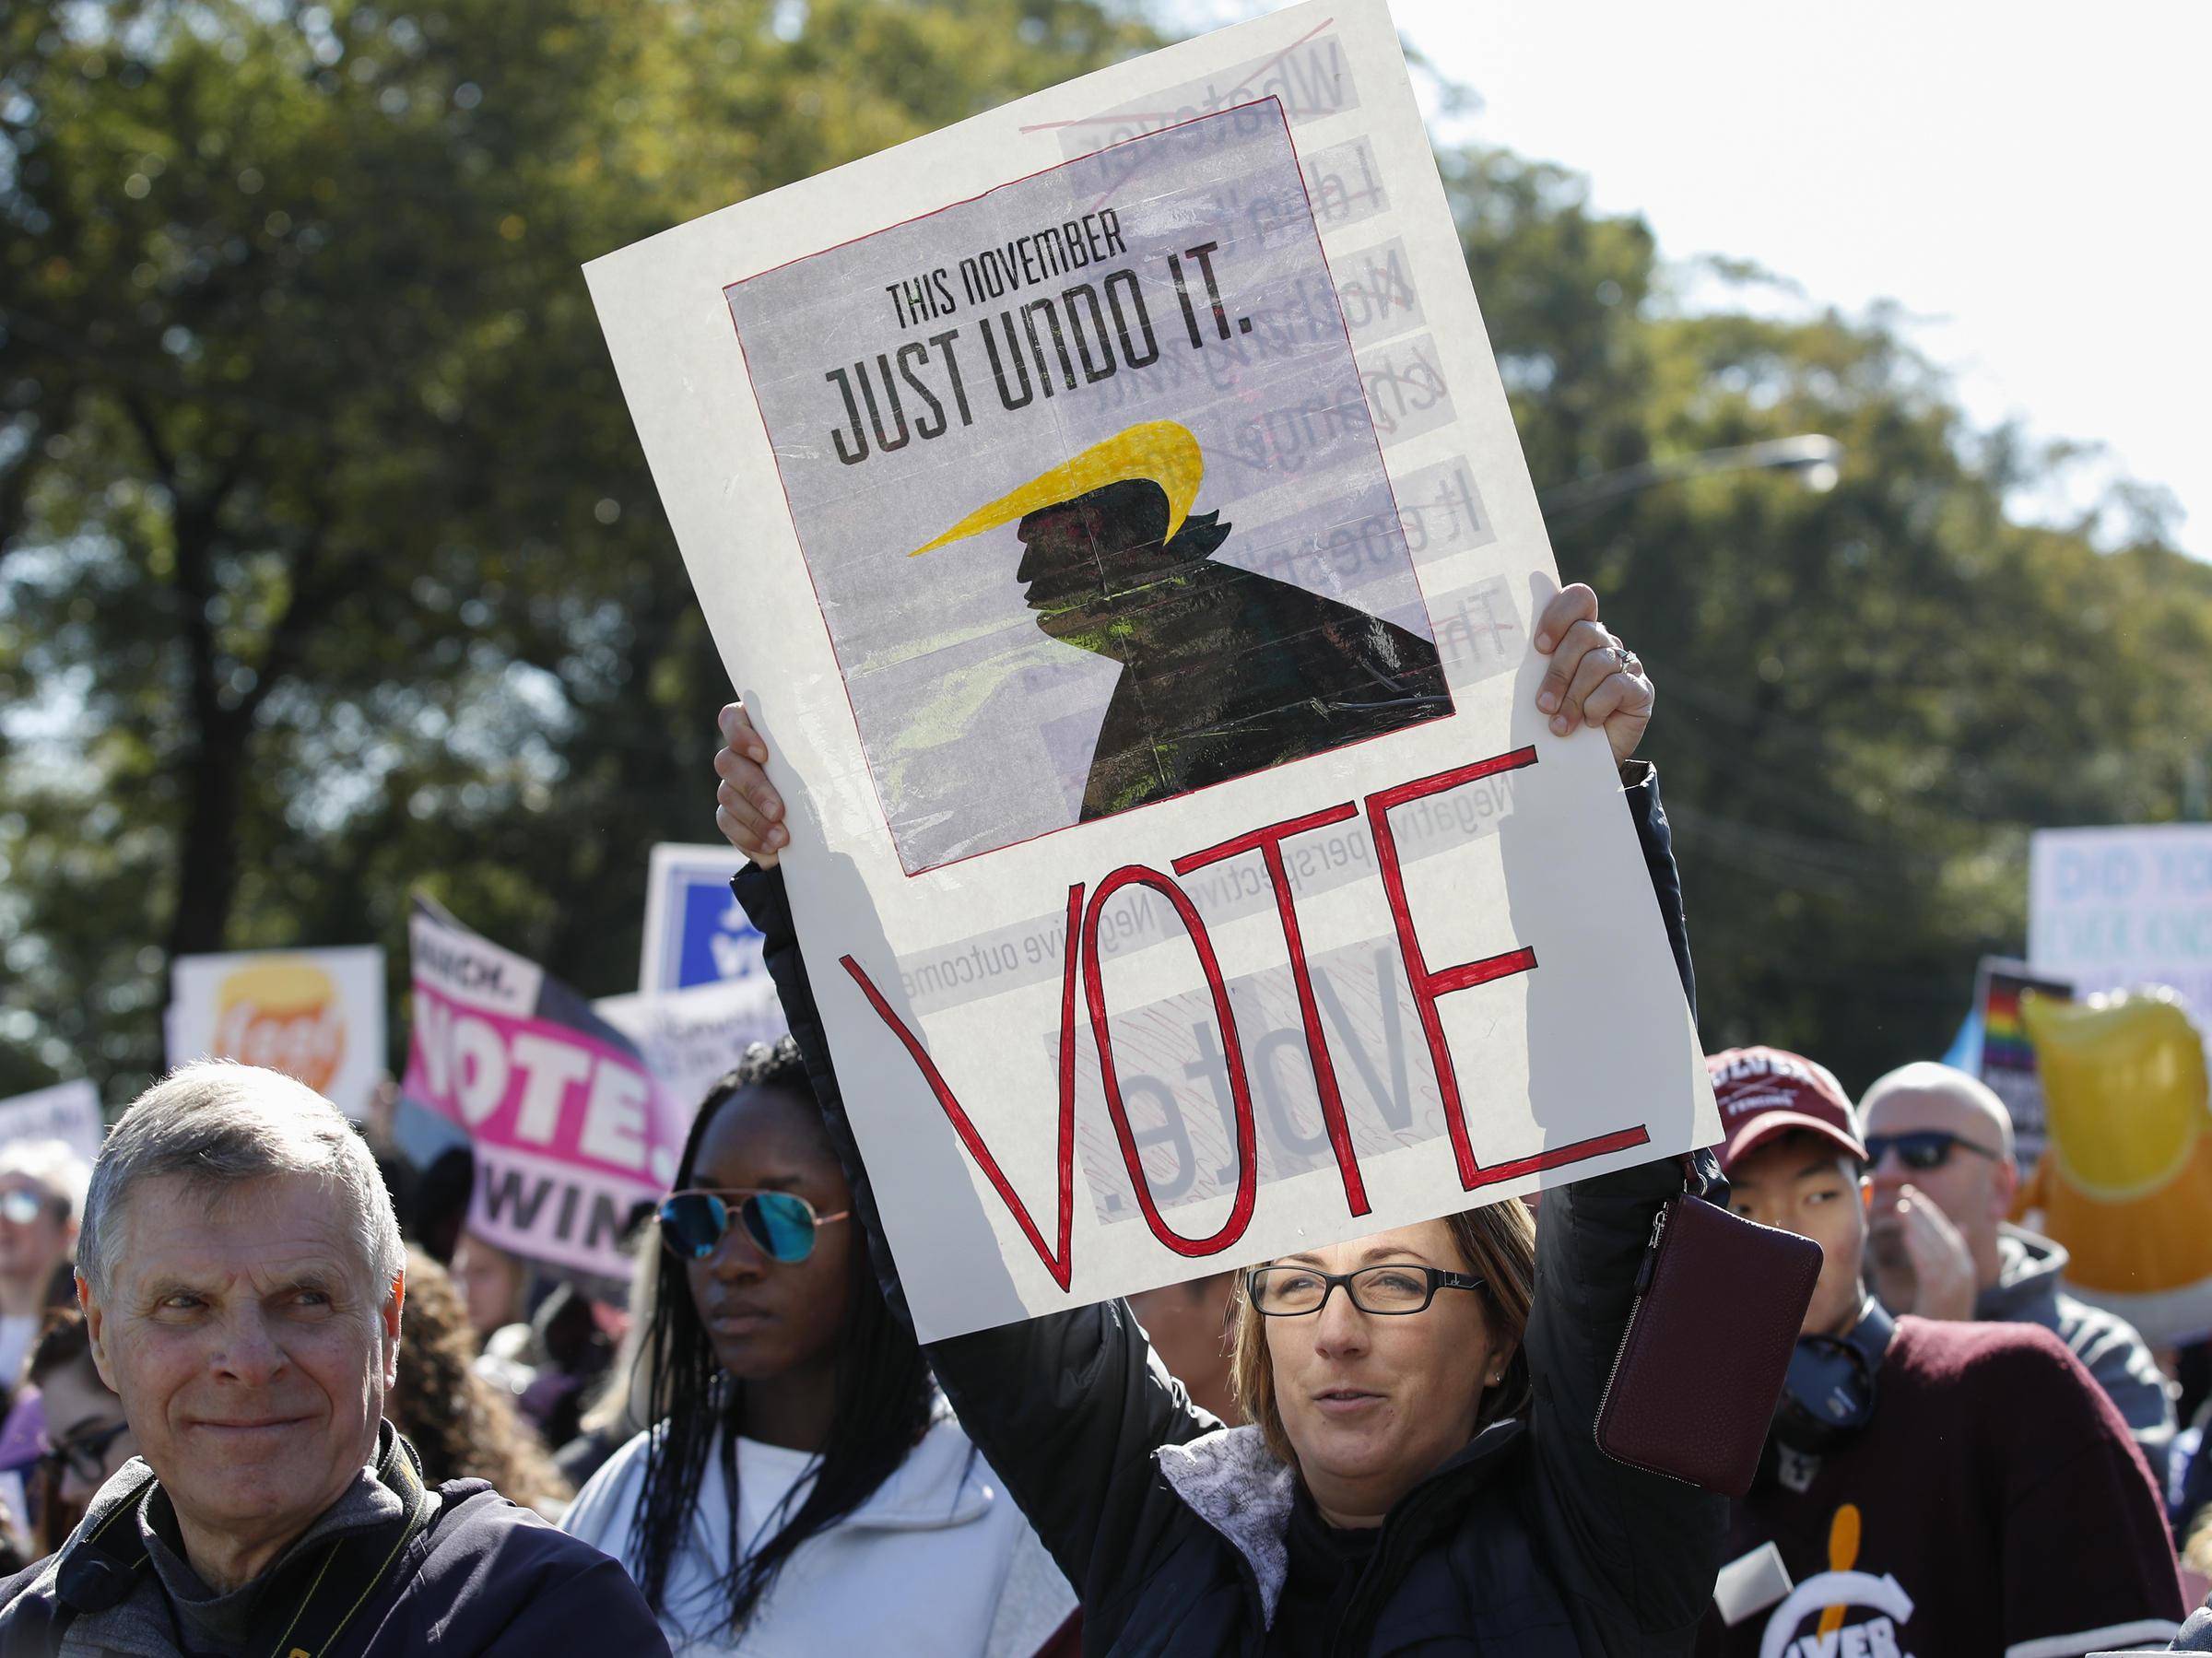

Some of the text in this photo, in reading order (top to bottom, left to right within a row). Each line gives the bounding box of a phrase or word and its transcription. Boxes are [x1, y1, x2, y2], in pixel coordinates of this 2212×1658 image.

[826, 329, 973, 465] JUST
[979, 268, 1159, 411] UNDO
[1166, 241, 1253, 349] IT.
[886, 207, 1127, 329] THIS NOVEMBER
[840, 745, 1649, 1290] VOTE
